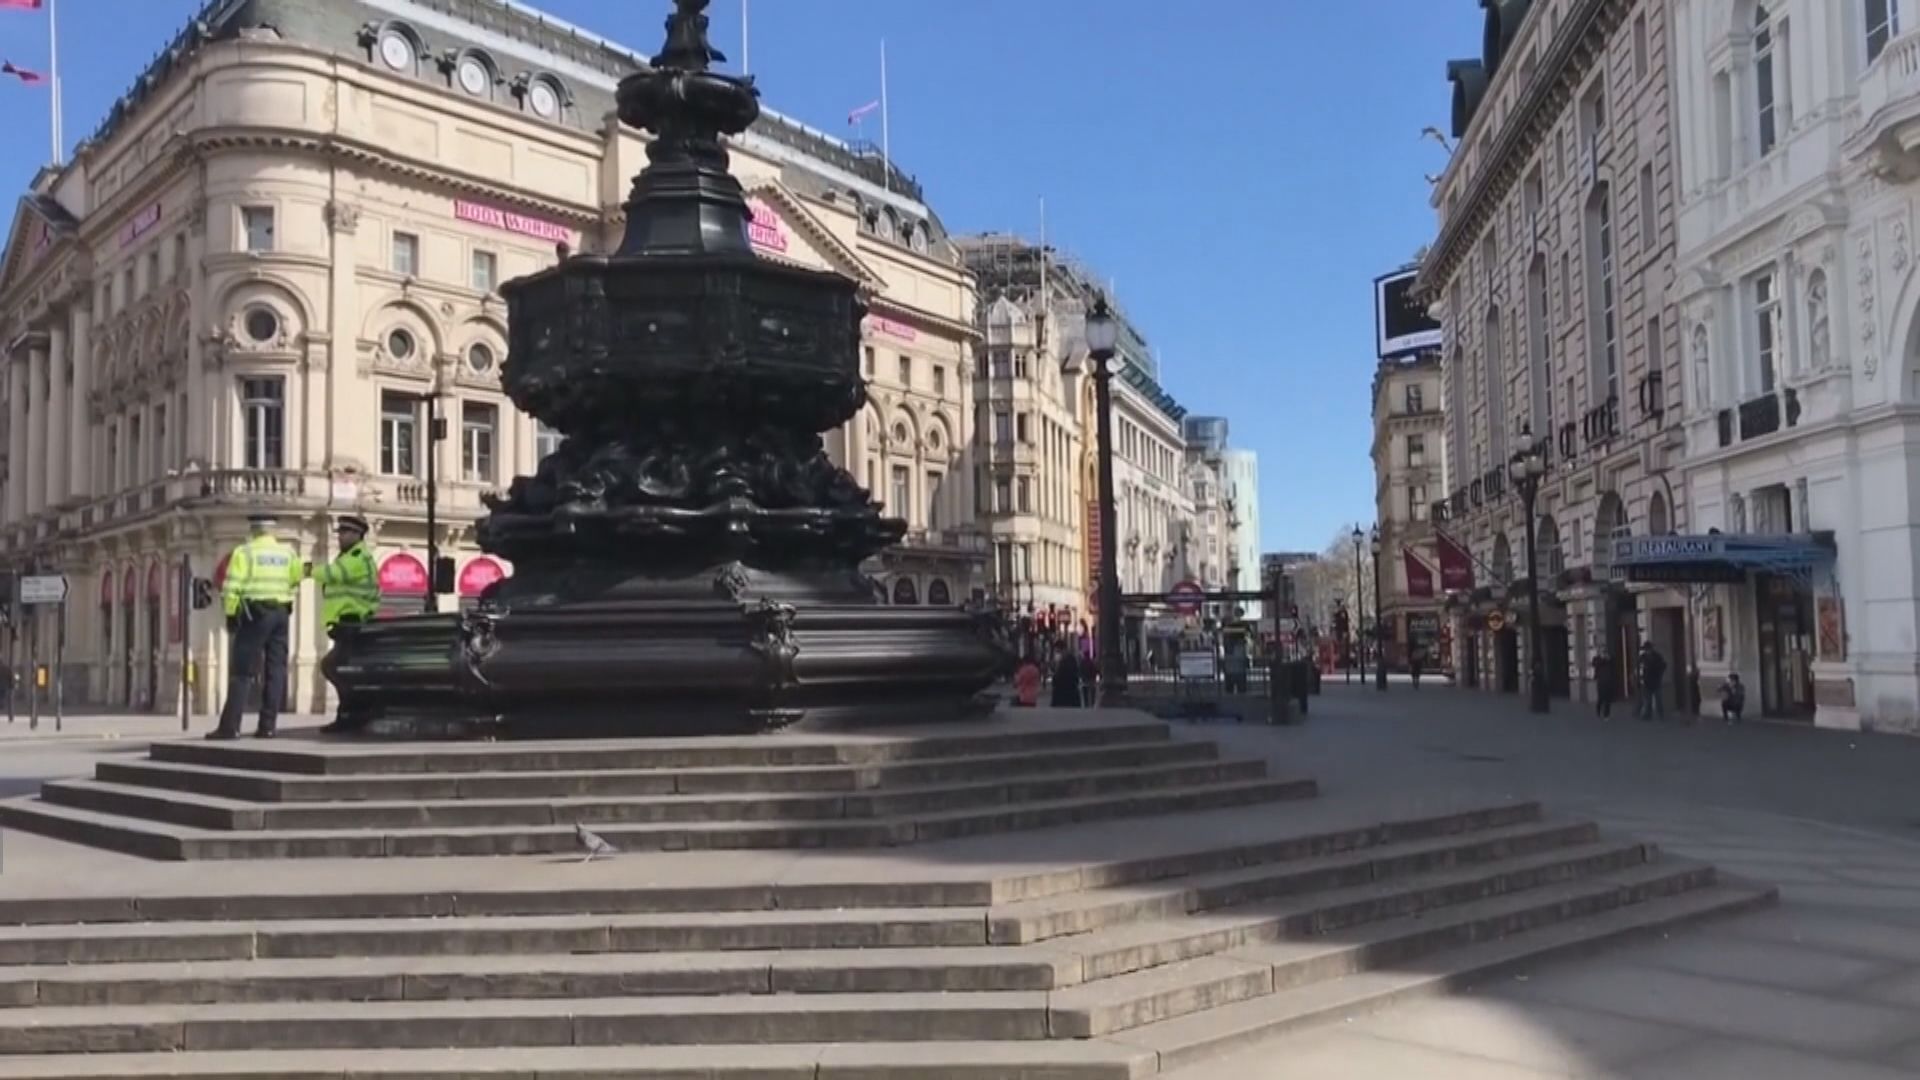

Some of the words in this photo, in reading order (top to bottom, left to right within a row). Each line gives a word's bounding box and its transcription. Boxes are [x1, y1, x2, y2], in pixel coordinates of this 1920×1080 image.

[457, 200, 500, 226] BODY
[750, 222, 787, 248] ORLDS
[1639, 540, 1711, 555] RESTAURANT
